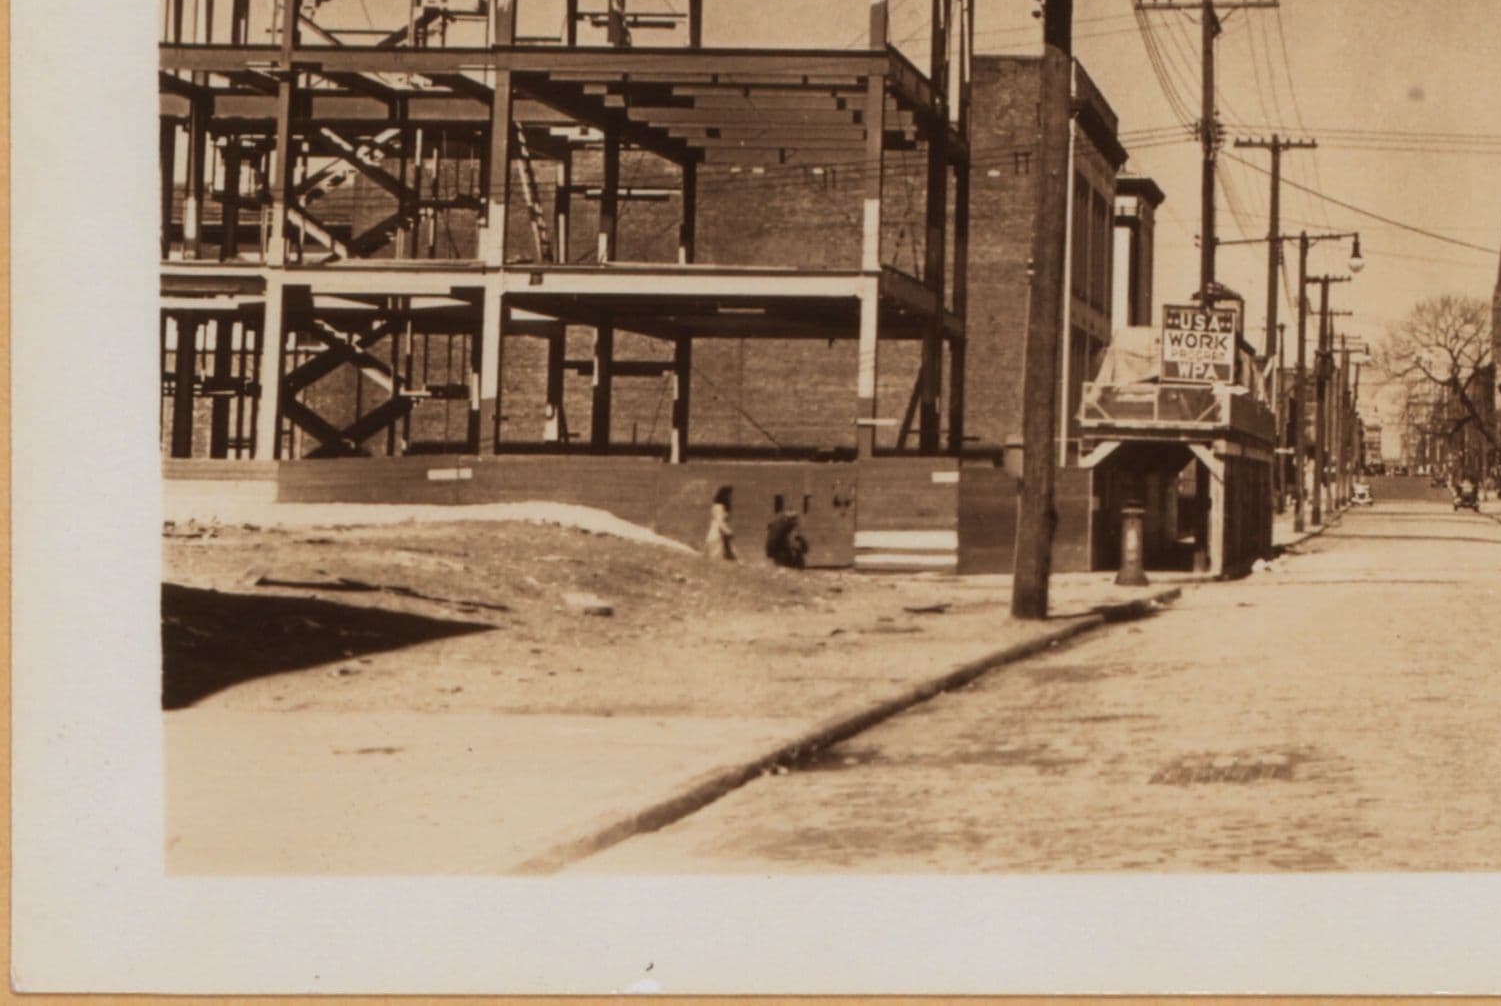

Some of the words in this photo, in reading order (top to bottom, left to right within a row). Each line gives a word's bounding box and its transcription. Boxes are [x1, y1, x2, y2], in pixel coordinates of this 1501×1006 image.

[1180, 313, 1220, 332] USA
[1168, 332, 1228, 350] WORK
[1177, 362, 1219, 380] WPA
